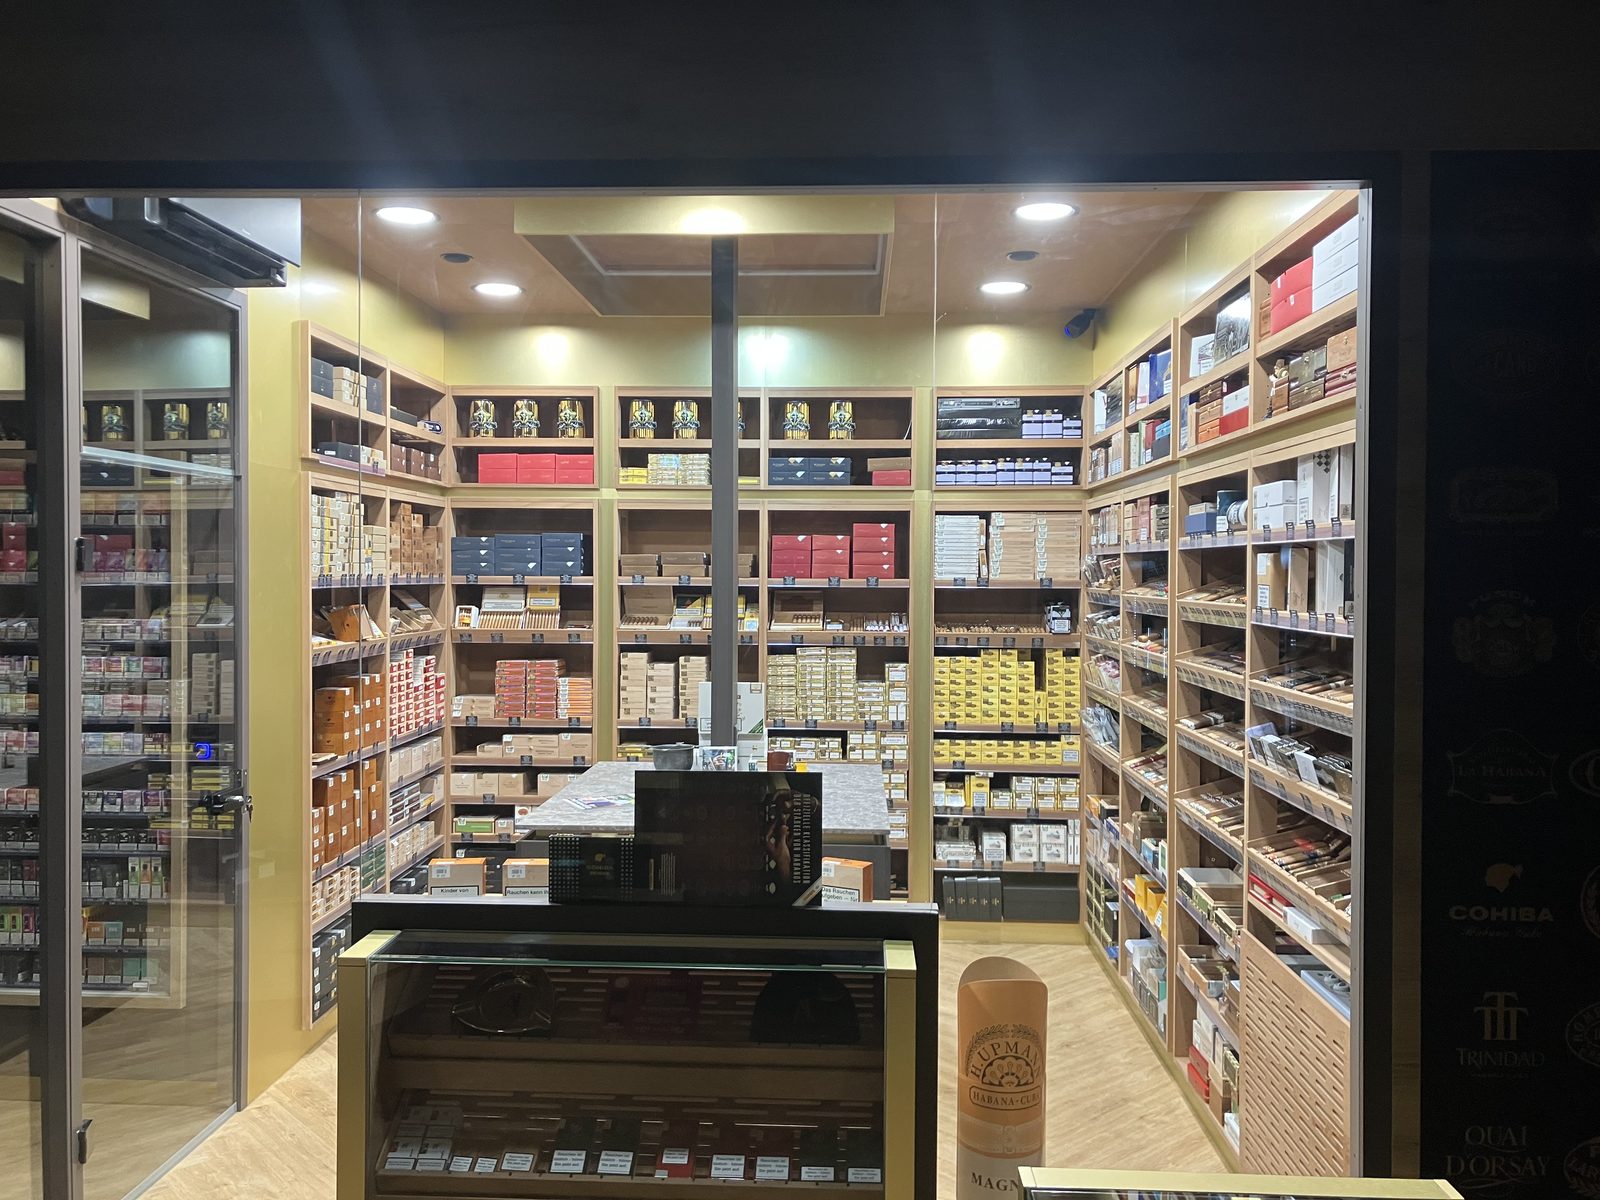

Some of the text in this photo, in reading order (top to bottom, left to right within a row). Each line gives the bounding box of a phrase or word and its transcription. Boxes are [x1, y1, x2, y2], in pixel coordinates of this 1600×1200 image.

[832, 887, 856, 896] Rauchen
[1448, 905, 1554, 922] COHIBA
[1455, 1047, 1545, 1071] TRINIDAD
[973, 1090, 1015, 1106] HABANA
[1464, 1125, 1528, 1147] QUAI
[970, 1171, 1019, 1191] MAGN
